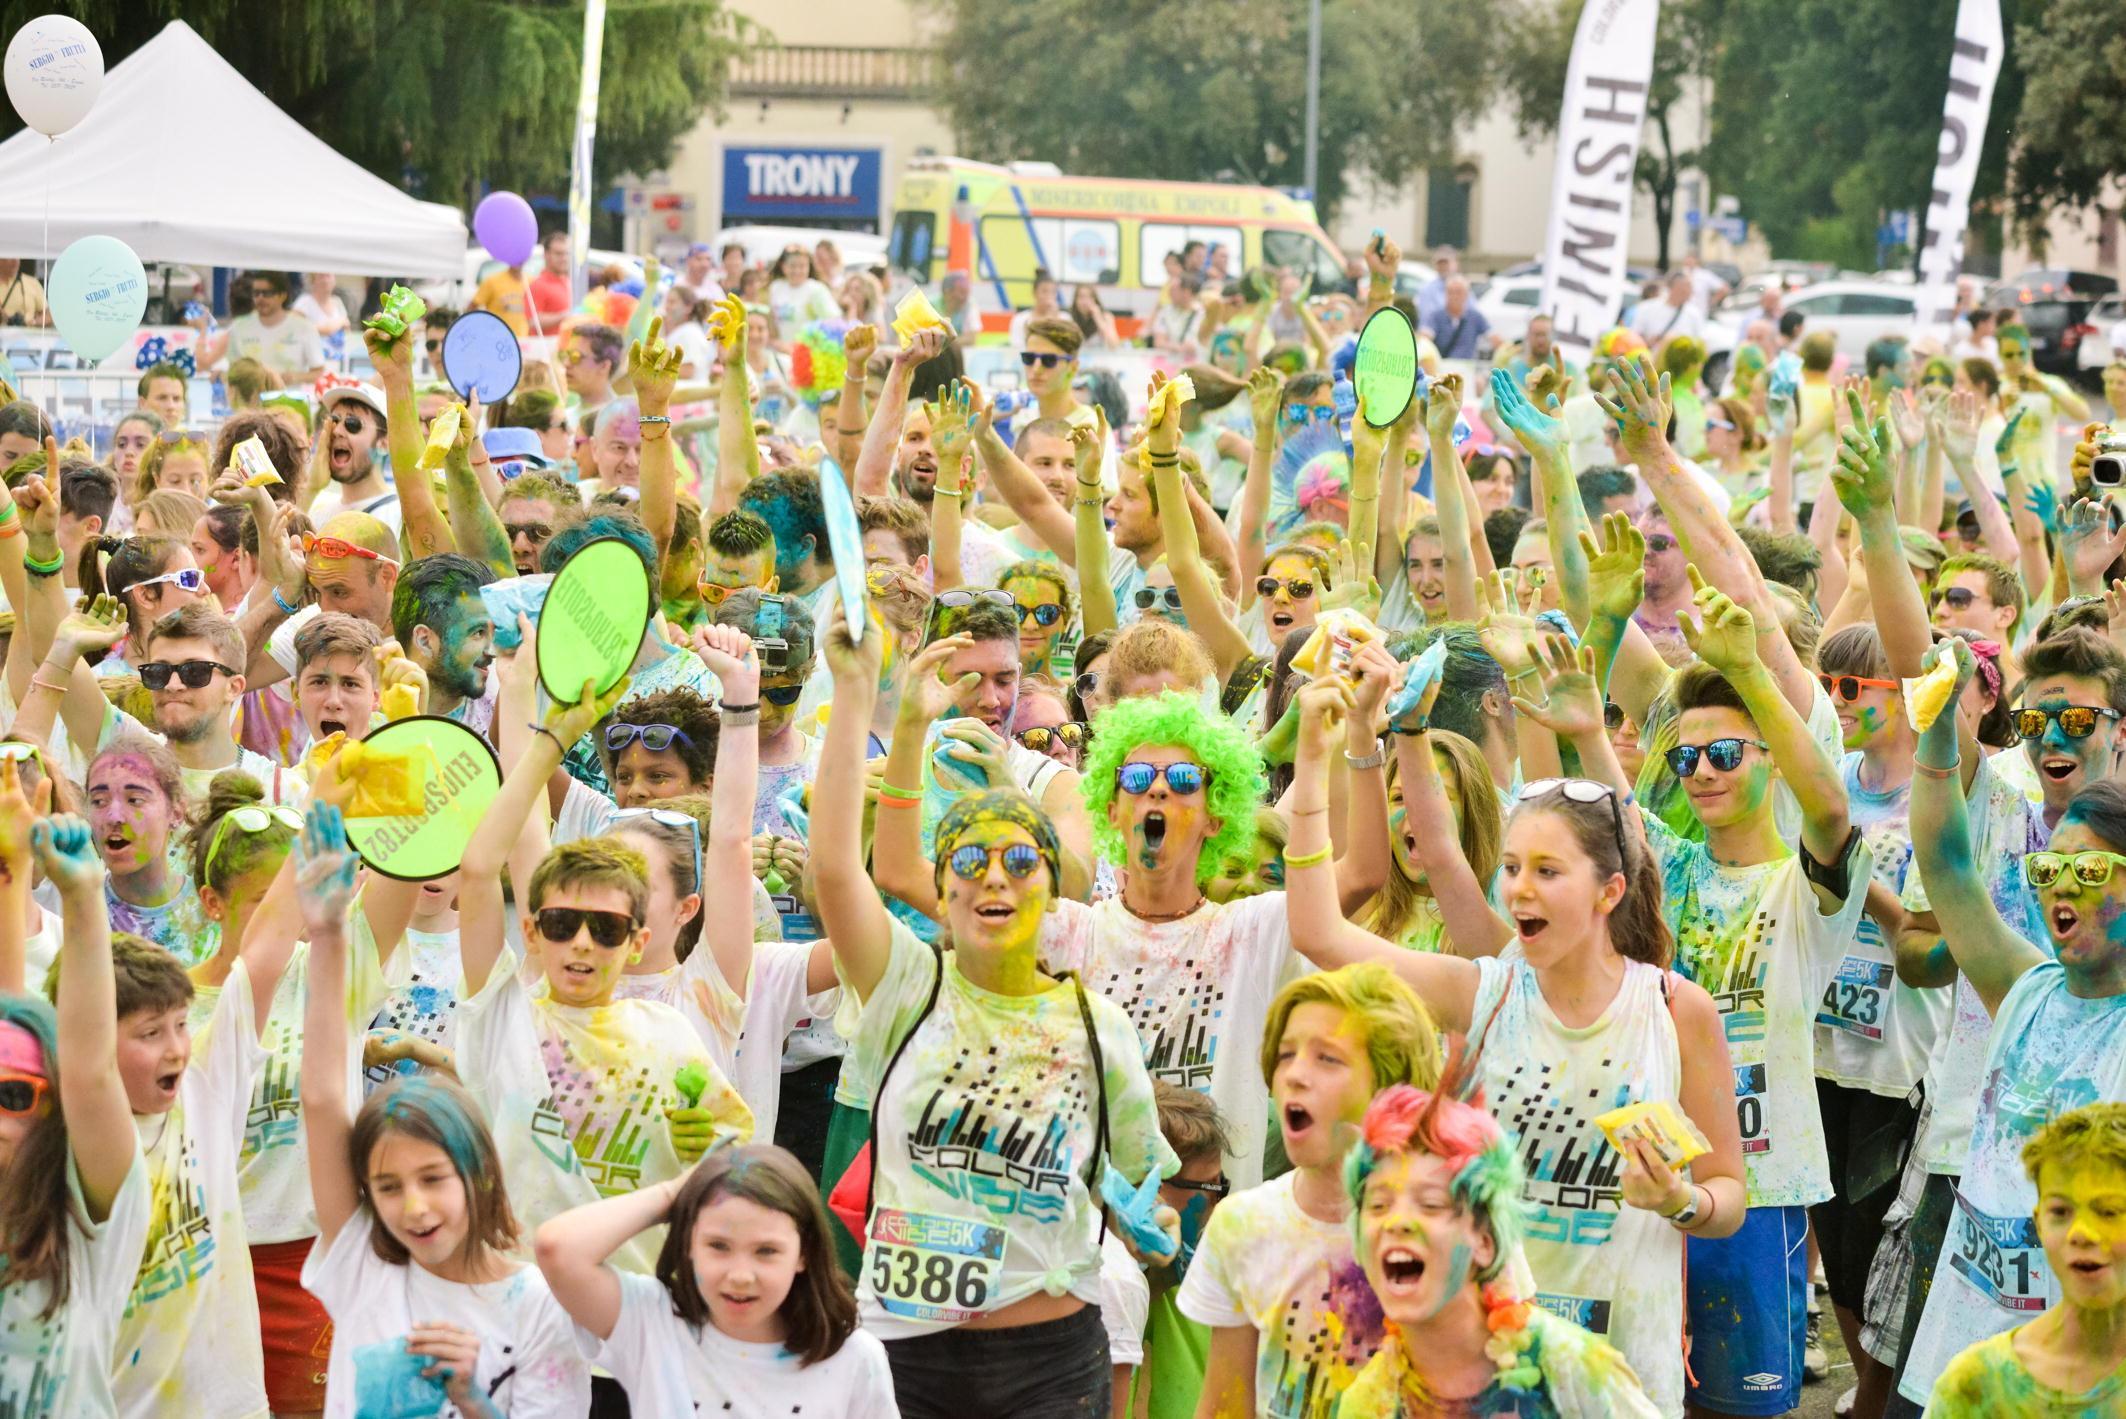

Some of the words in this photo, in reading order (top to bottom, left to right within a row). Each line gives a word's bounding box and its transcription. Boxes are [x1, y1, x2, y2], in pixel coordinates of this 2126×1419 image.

[29, 52, 55, 71] SERGIO
[743, 153, 860, 196] TRONY
[85, 287, 111, 304] SERGIO
[363, 750, 483, 863] ELIOSPRT82
[1856, 961, 1874, 980] 5K
[908, 1143, 1070, 1196] COLOR
[950, 1221, 977, 1248] 5K
[1993, 1219, 2018, 1242] 5K
[1963, 1216, 2029, 1295] 9231
[872, 1245, 989, 1308] 5386
[1560, 1296, 1583, 1323] 5K
